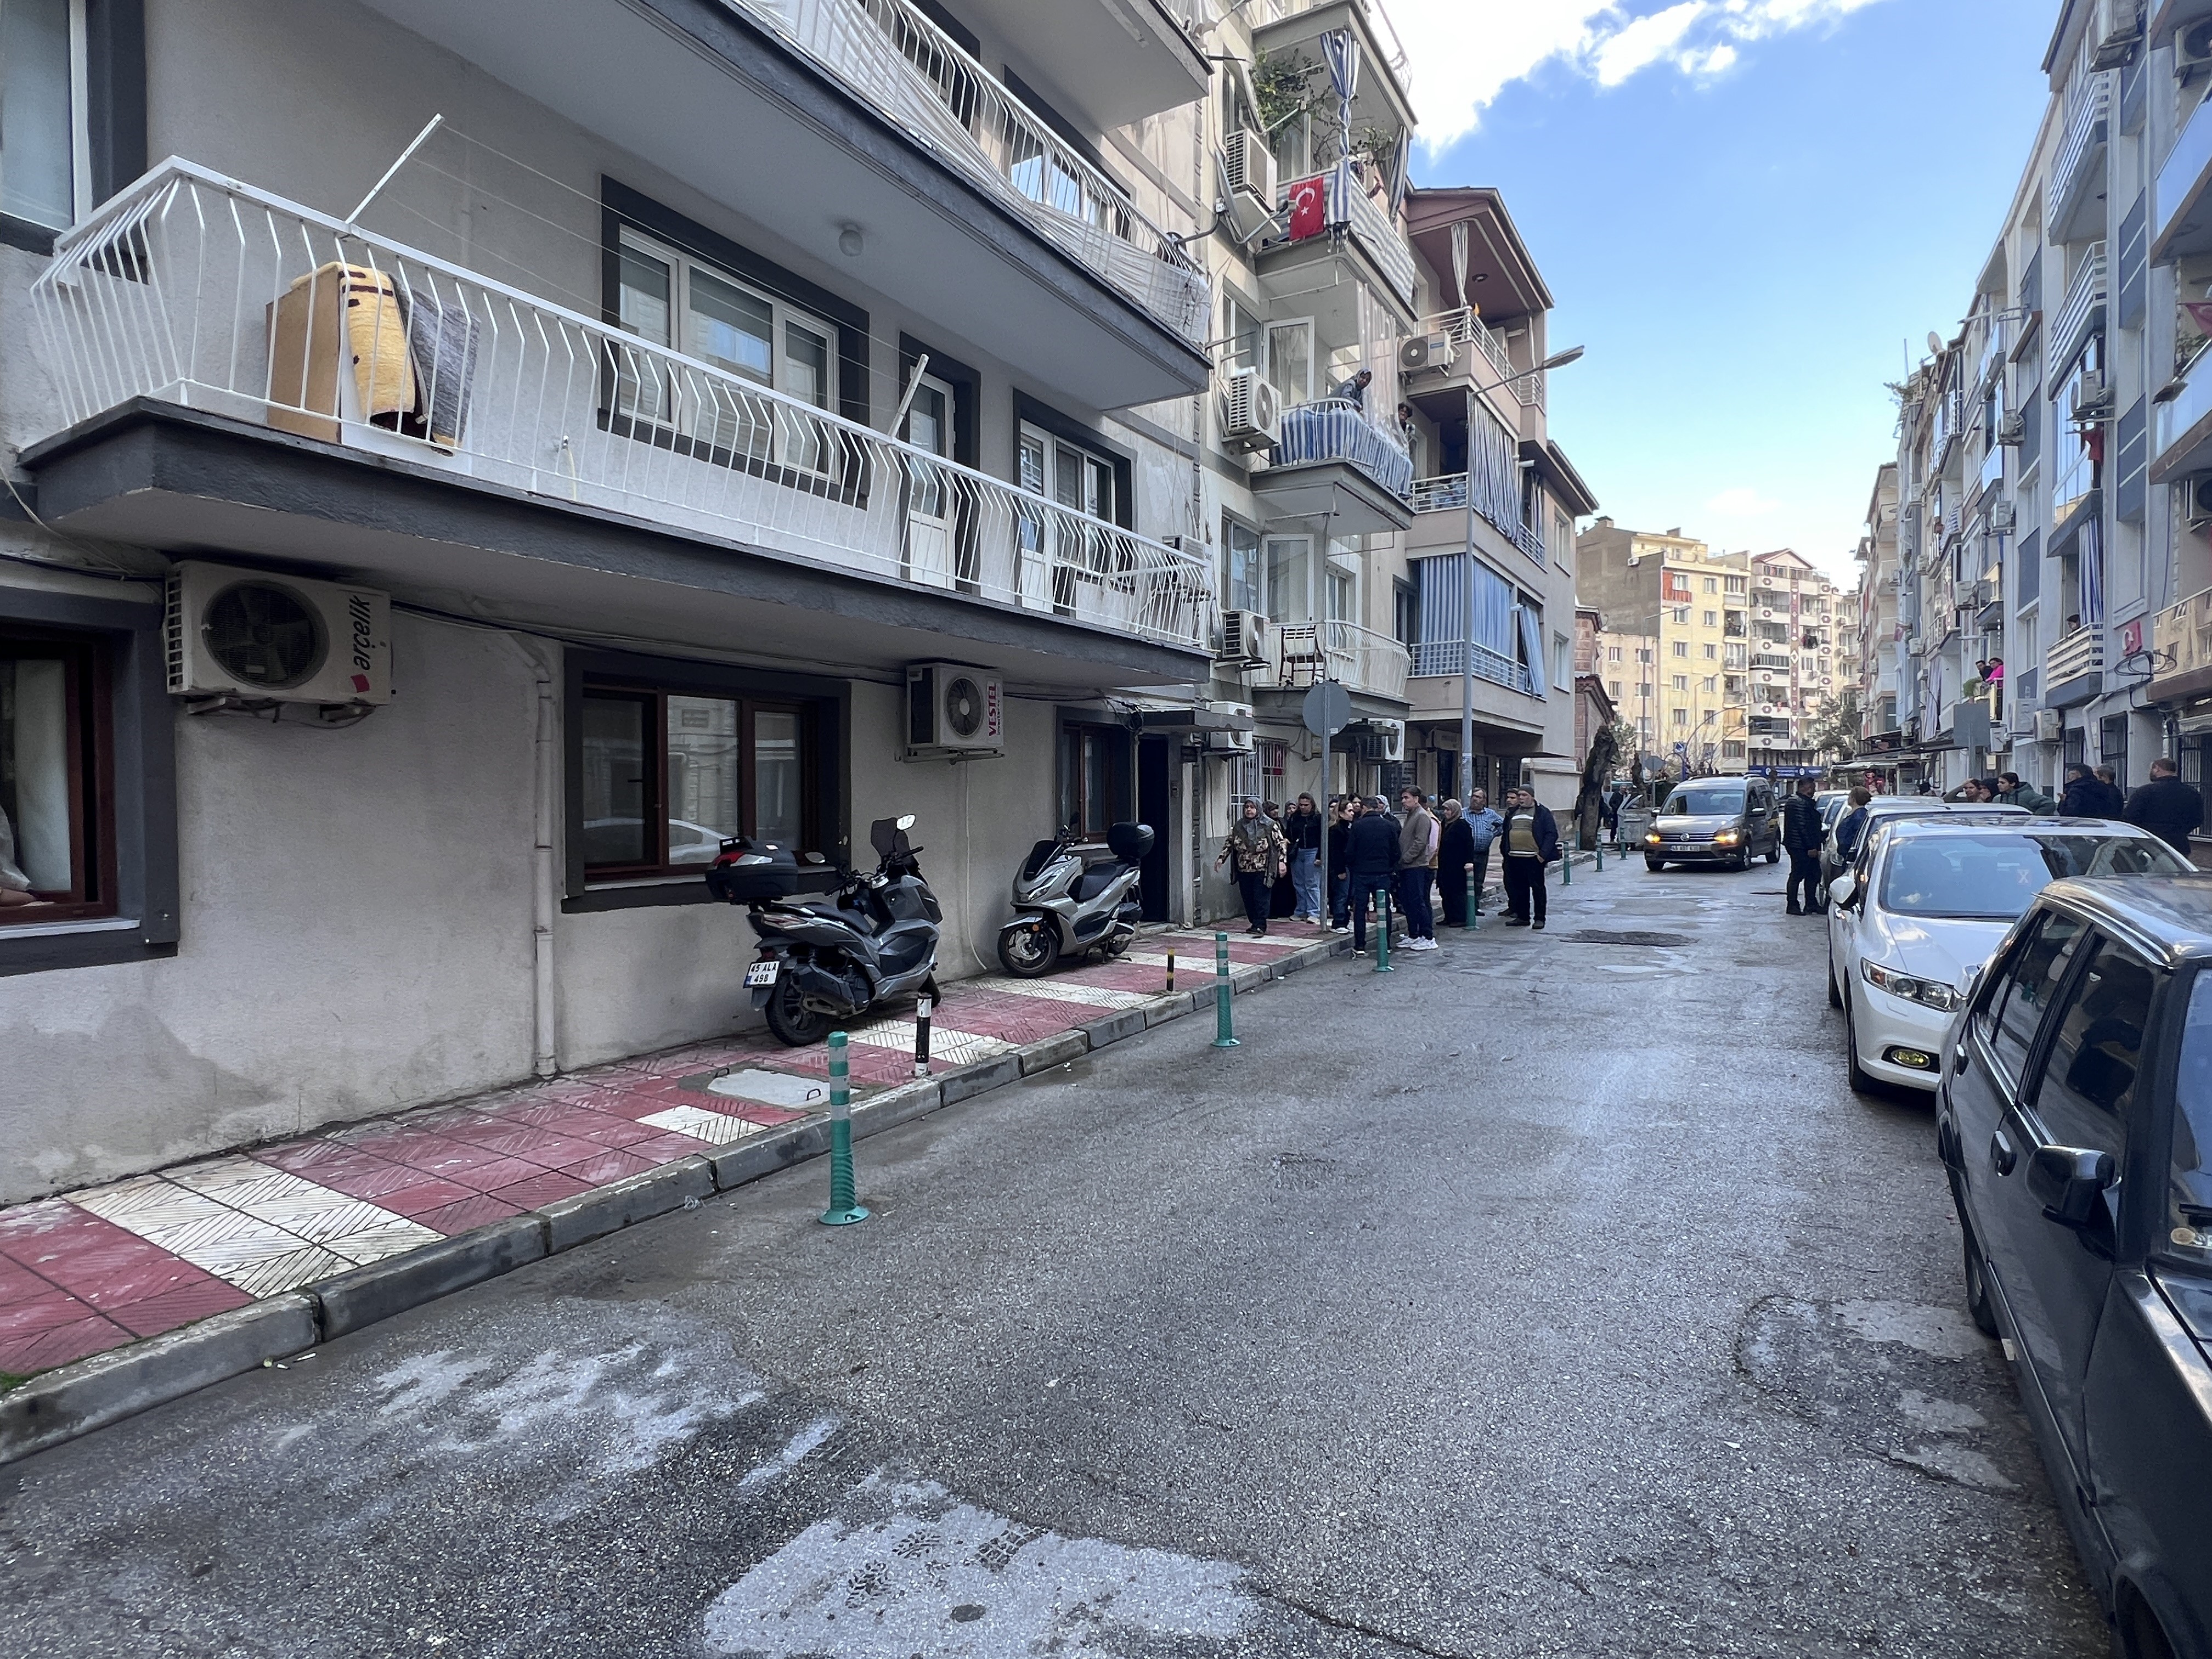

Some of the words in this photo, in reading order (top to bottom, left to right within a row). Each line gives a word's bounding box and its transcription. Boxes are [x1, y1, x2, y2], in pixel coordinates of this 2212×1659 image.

[349, 595, 375, 670] arçelik
[988, 682, 996, 737] VESTEL
[751, 964, 760, 972] 45
[762, 963, 777, 972] ALA
[754, 974, 769, 983] 498
